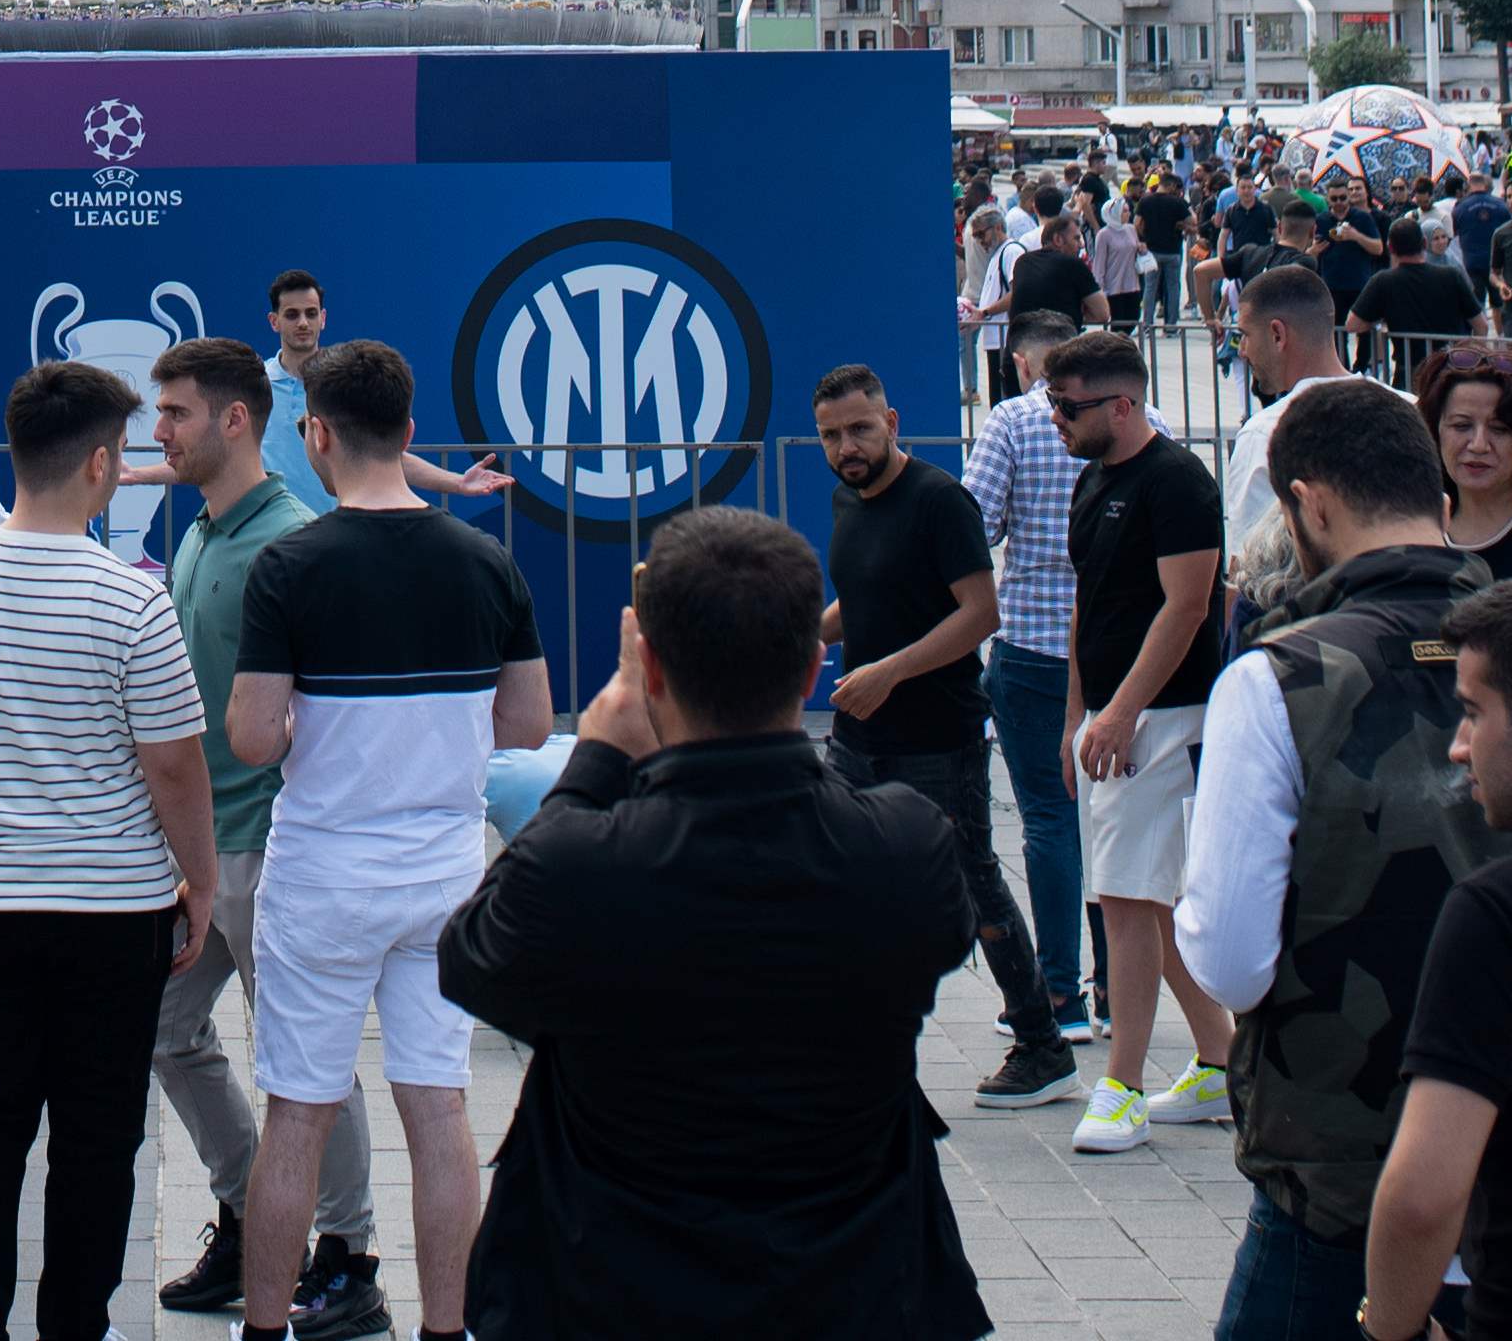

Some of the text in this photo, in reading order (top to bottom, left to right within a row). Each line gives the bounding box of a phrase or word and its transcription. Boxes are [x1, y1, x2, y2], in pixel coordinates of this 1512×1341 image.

[94, 170, 136, 186] UEFA
[49, 189, 183, 207] CHAMPIONS
[74, 210, 160, 227] LEAGUE
